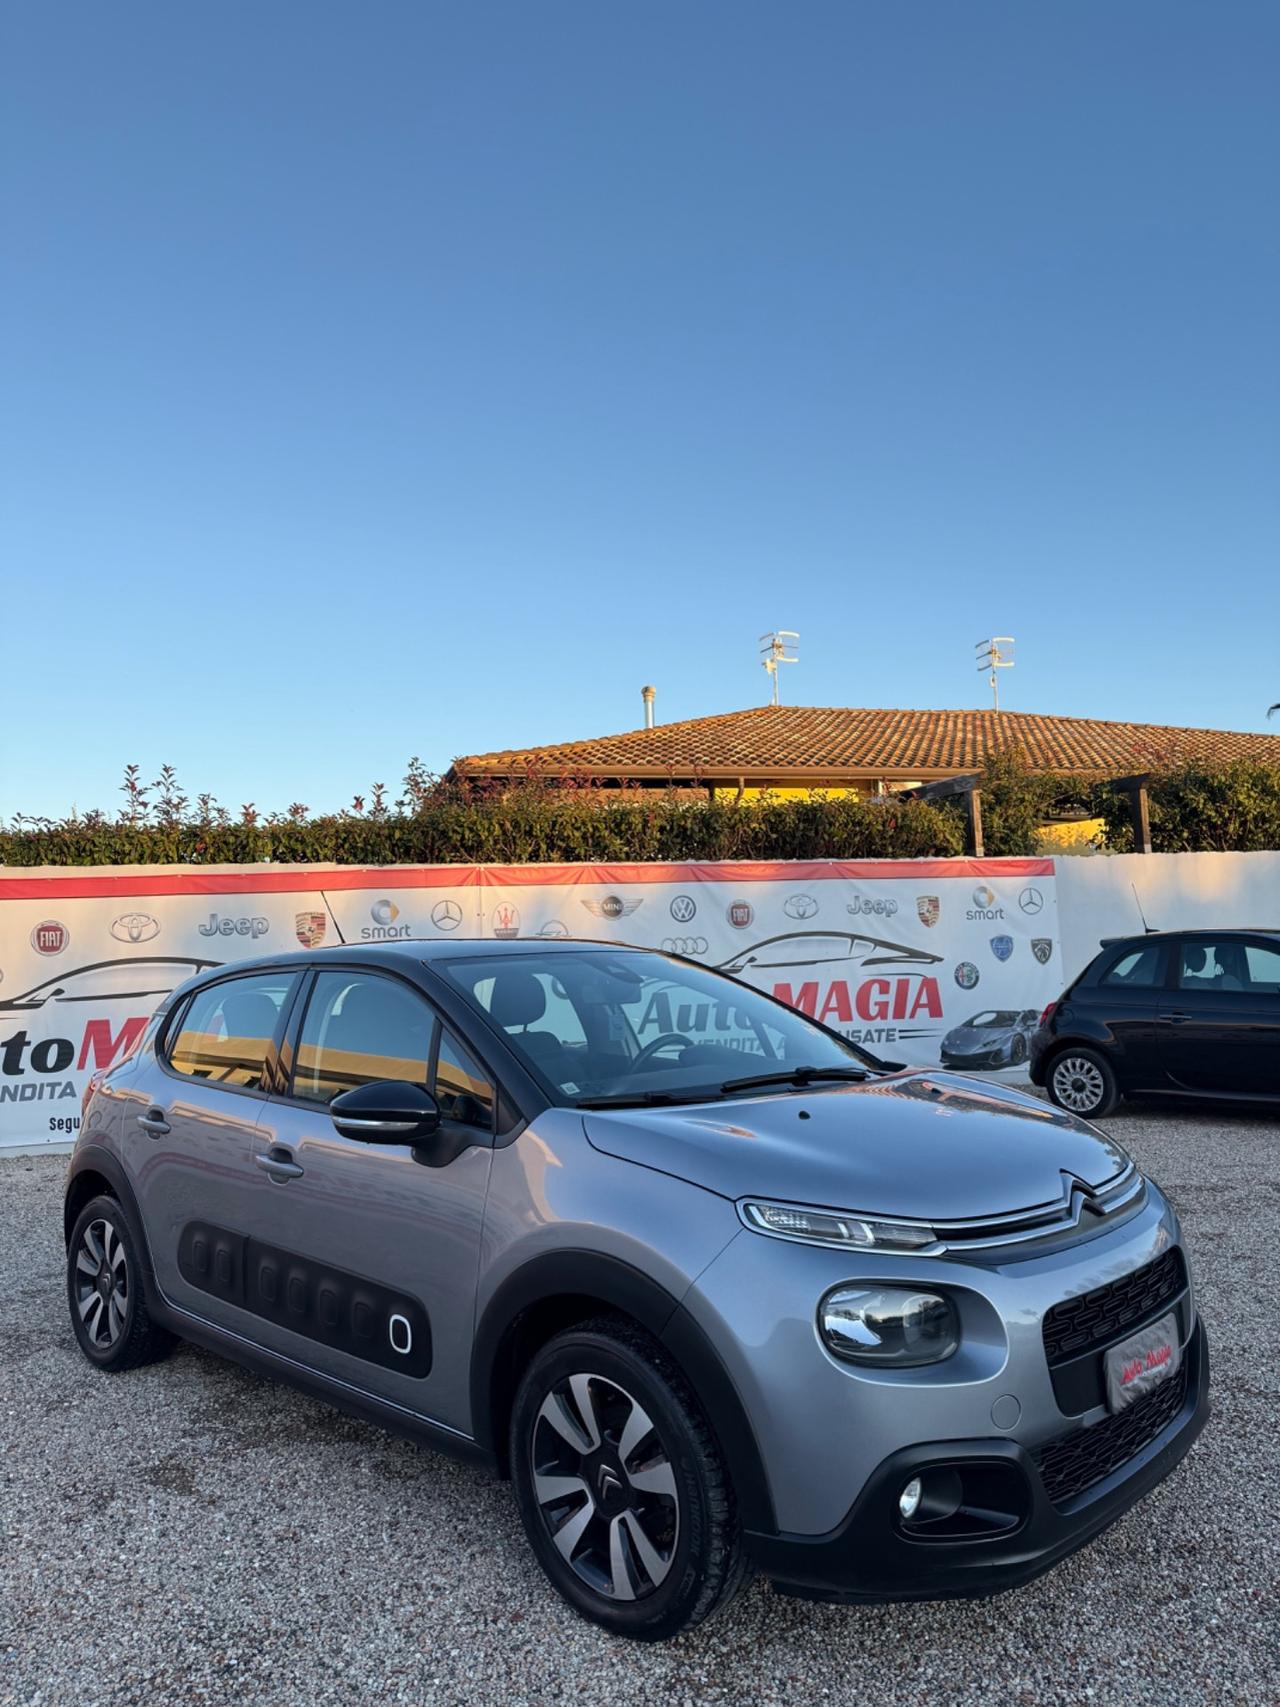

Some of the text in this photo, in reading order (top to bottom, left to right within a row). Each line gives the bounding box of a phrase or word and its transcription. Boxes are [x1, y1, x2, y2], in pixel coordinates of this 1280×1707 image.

[845, 896, 898, 917] Jeep
[966, 908, 1004, 920] smart
[199, 913, 269, 939] Jeep
[361, 924, 411, 939] smart
[40, 930, 62, 947] FIAT
[771, 977, 943, 1022] MAGIA
[0, 1081, 77, 1102] NDITA
